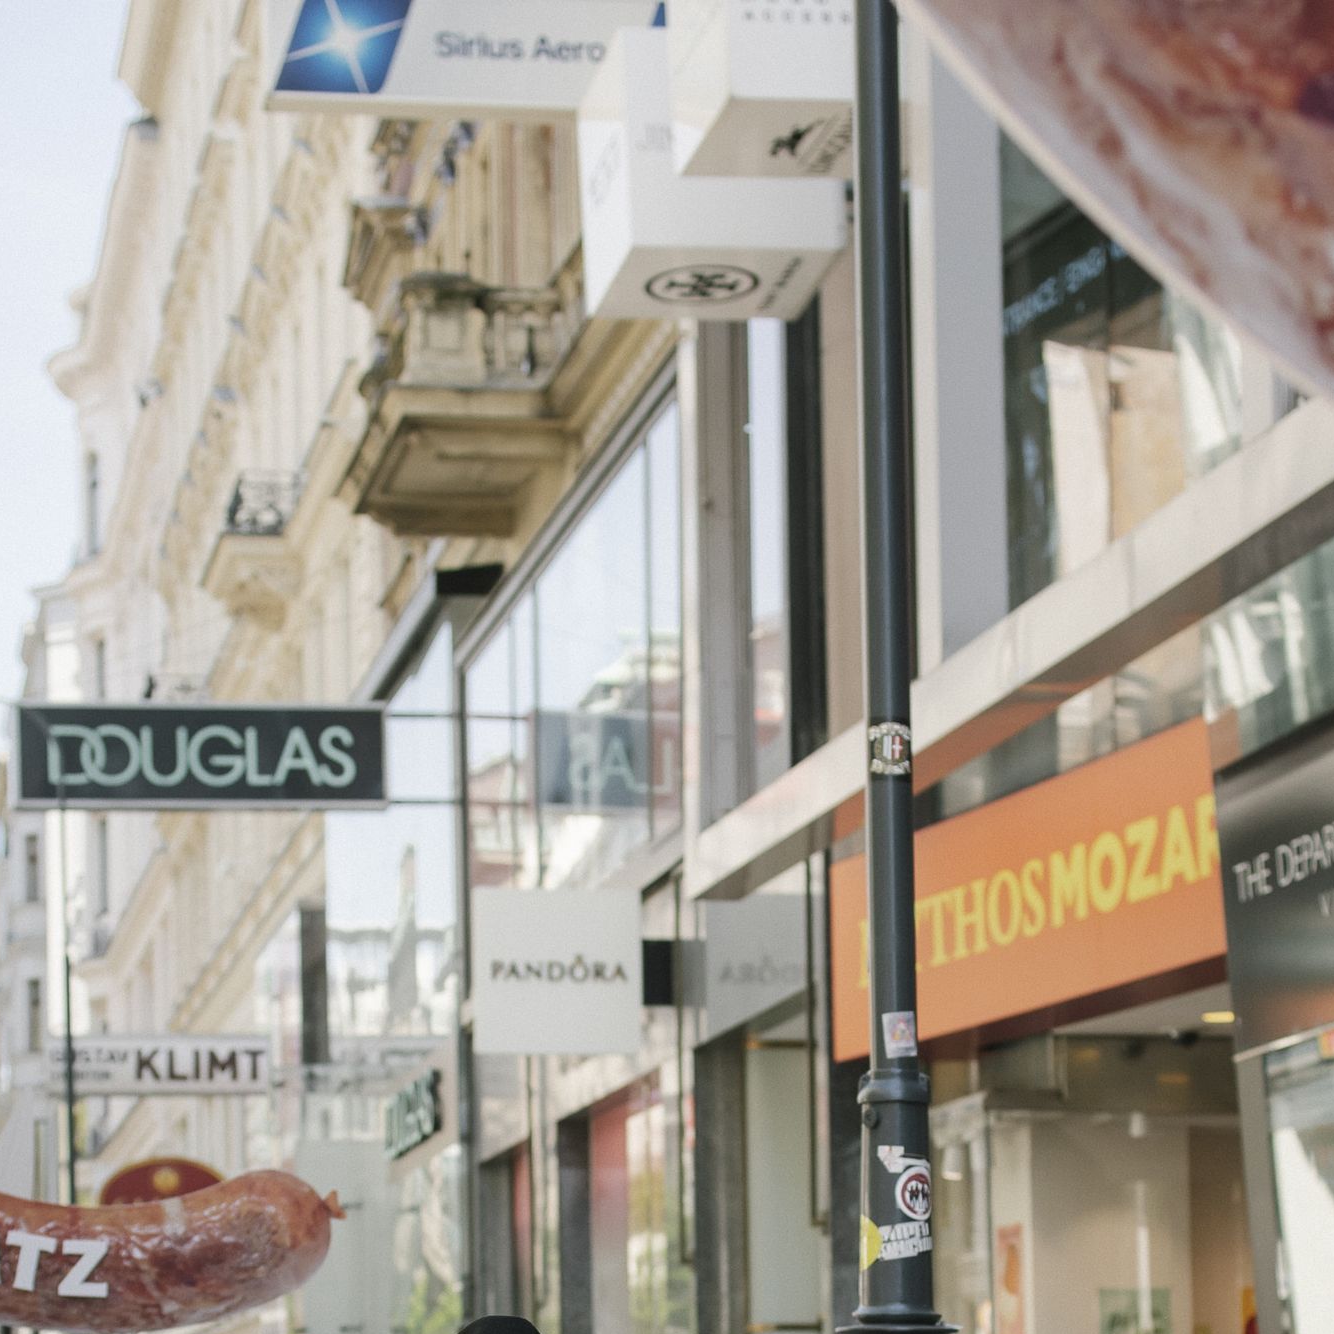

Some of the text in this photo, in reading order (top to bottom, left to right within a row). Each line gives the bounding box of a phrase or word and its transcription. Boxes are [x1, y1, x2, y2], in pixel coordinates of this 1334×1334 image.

[435, 31, 605, 62] Sirius Aero
[47, 724, 357, 788] DOUGLAS
[1232, 851, 1273, 903] THE
[136, 1049, 265, 1081] KLIMT
